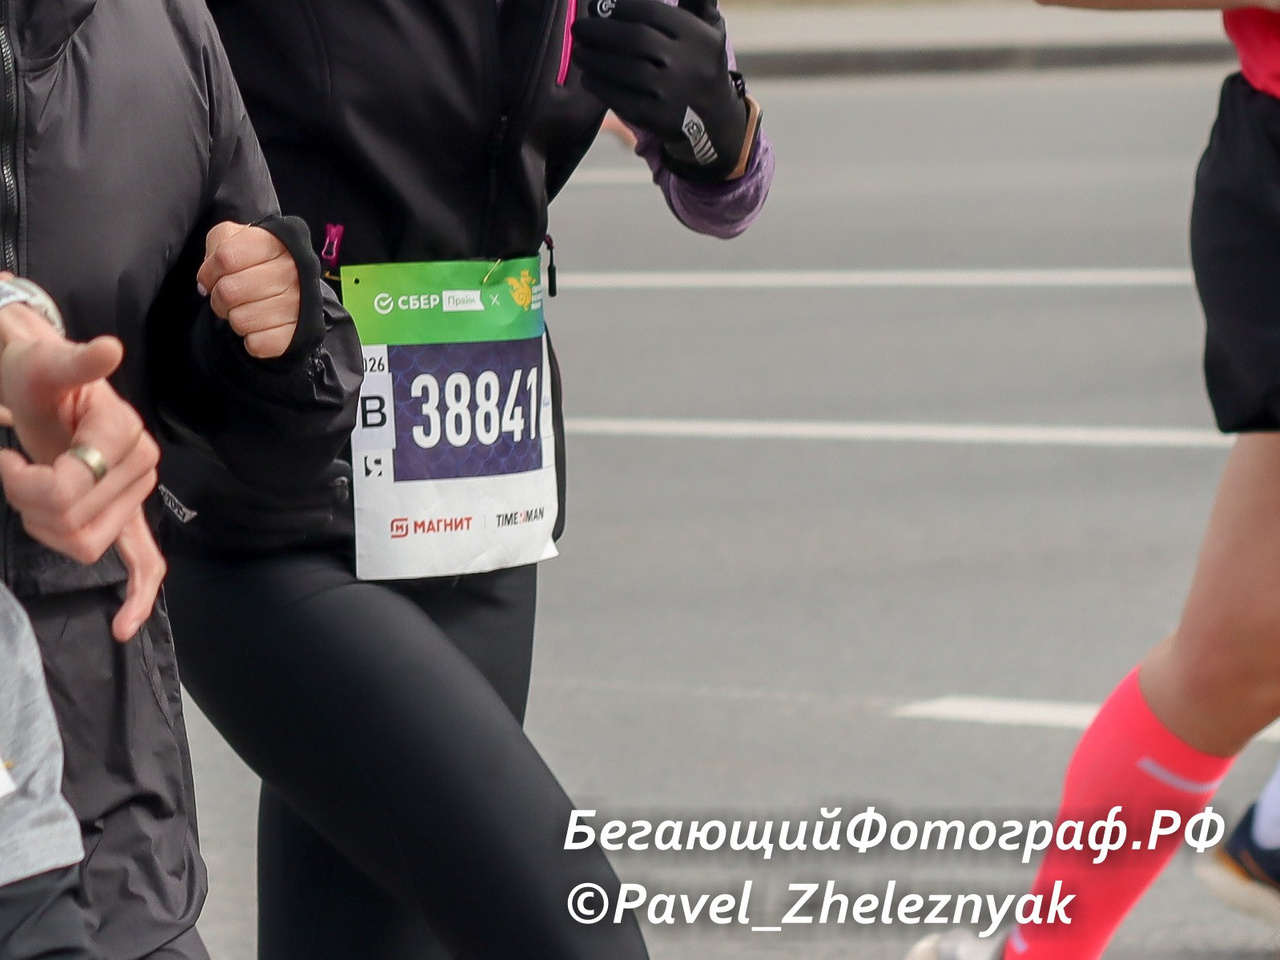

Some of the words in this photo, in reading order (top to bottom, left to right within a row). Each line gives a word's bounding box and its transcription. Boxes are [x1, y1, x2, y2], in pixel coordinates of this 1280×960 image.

[397, 293, 440, 310] СБЕР
[363, 356, 385, 373] 26
[410, 366, 539, 450] 38841
[412, 515, 473, 535] МАГНИТ
